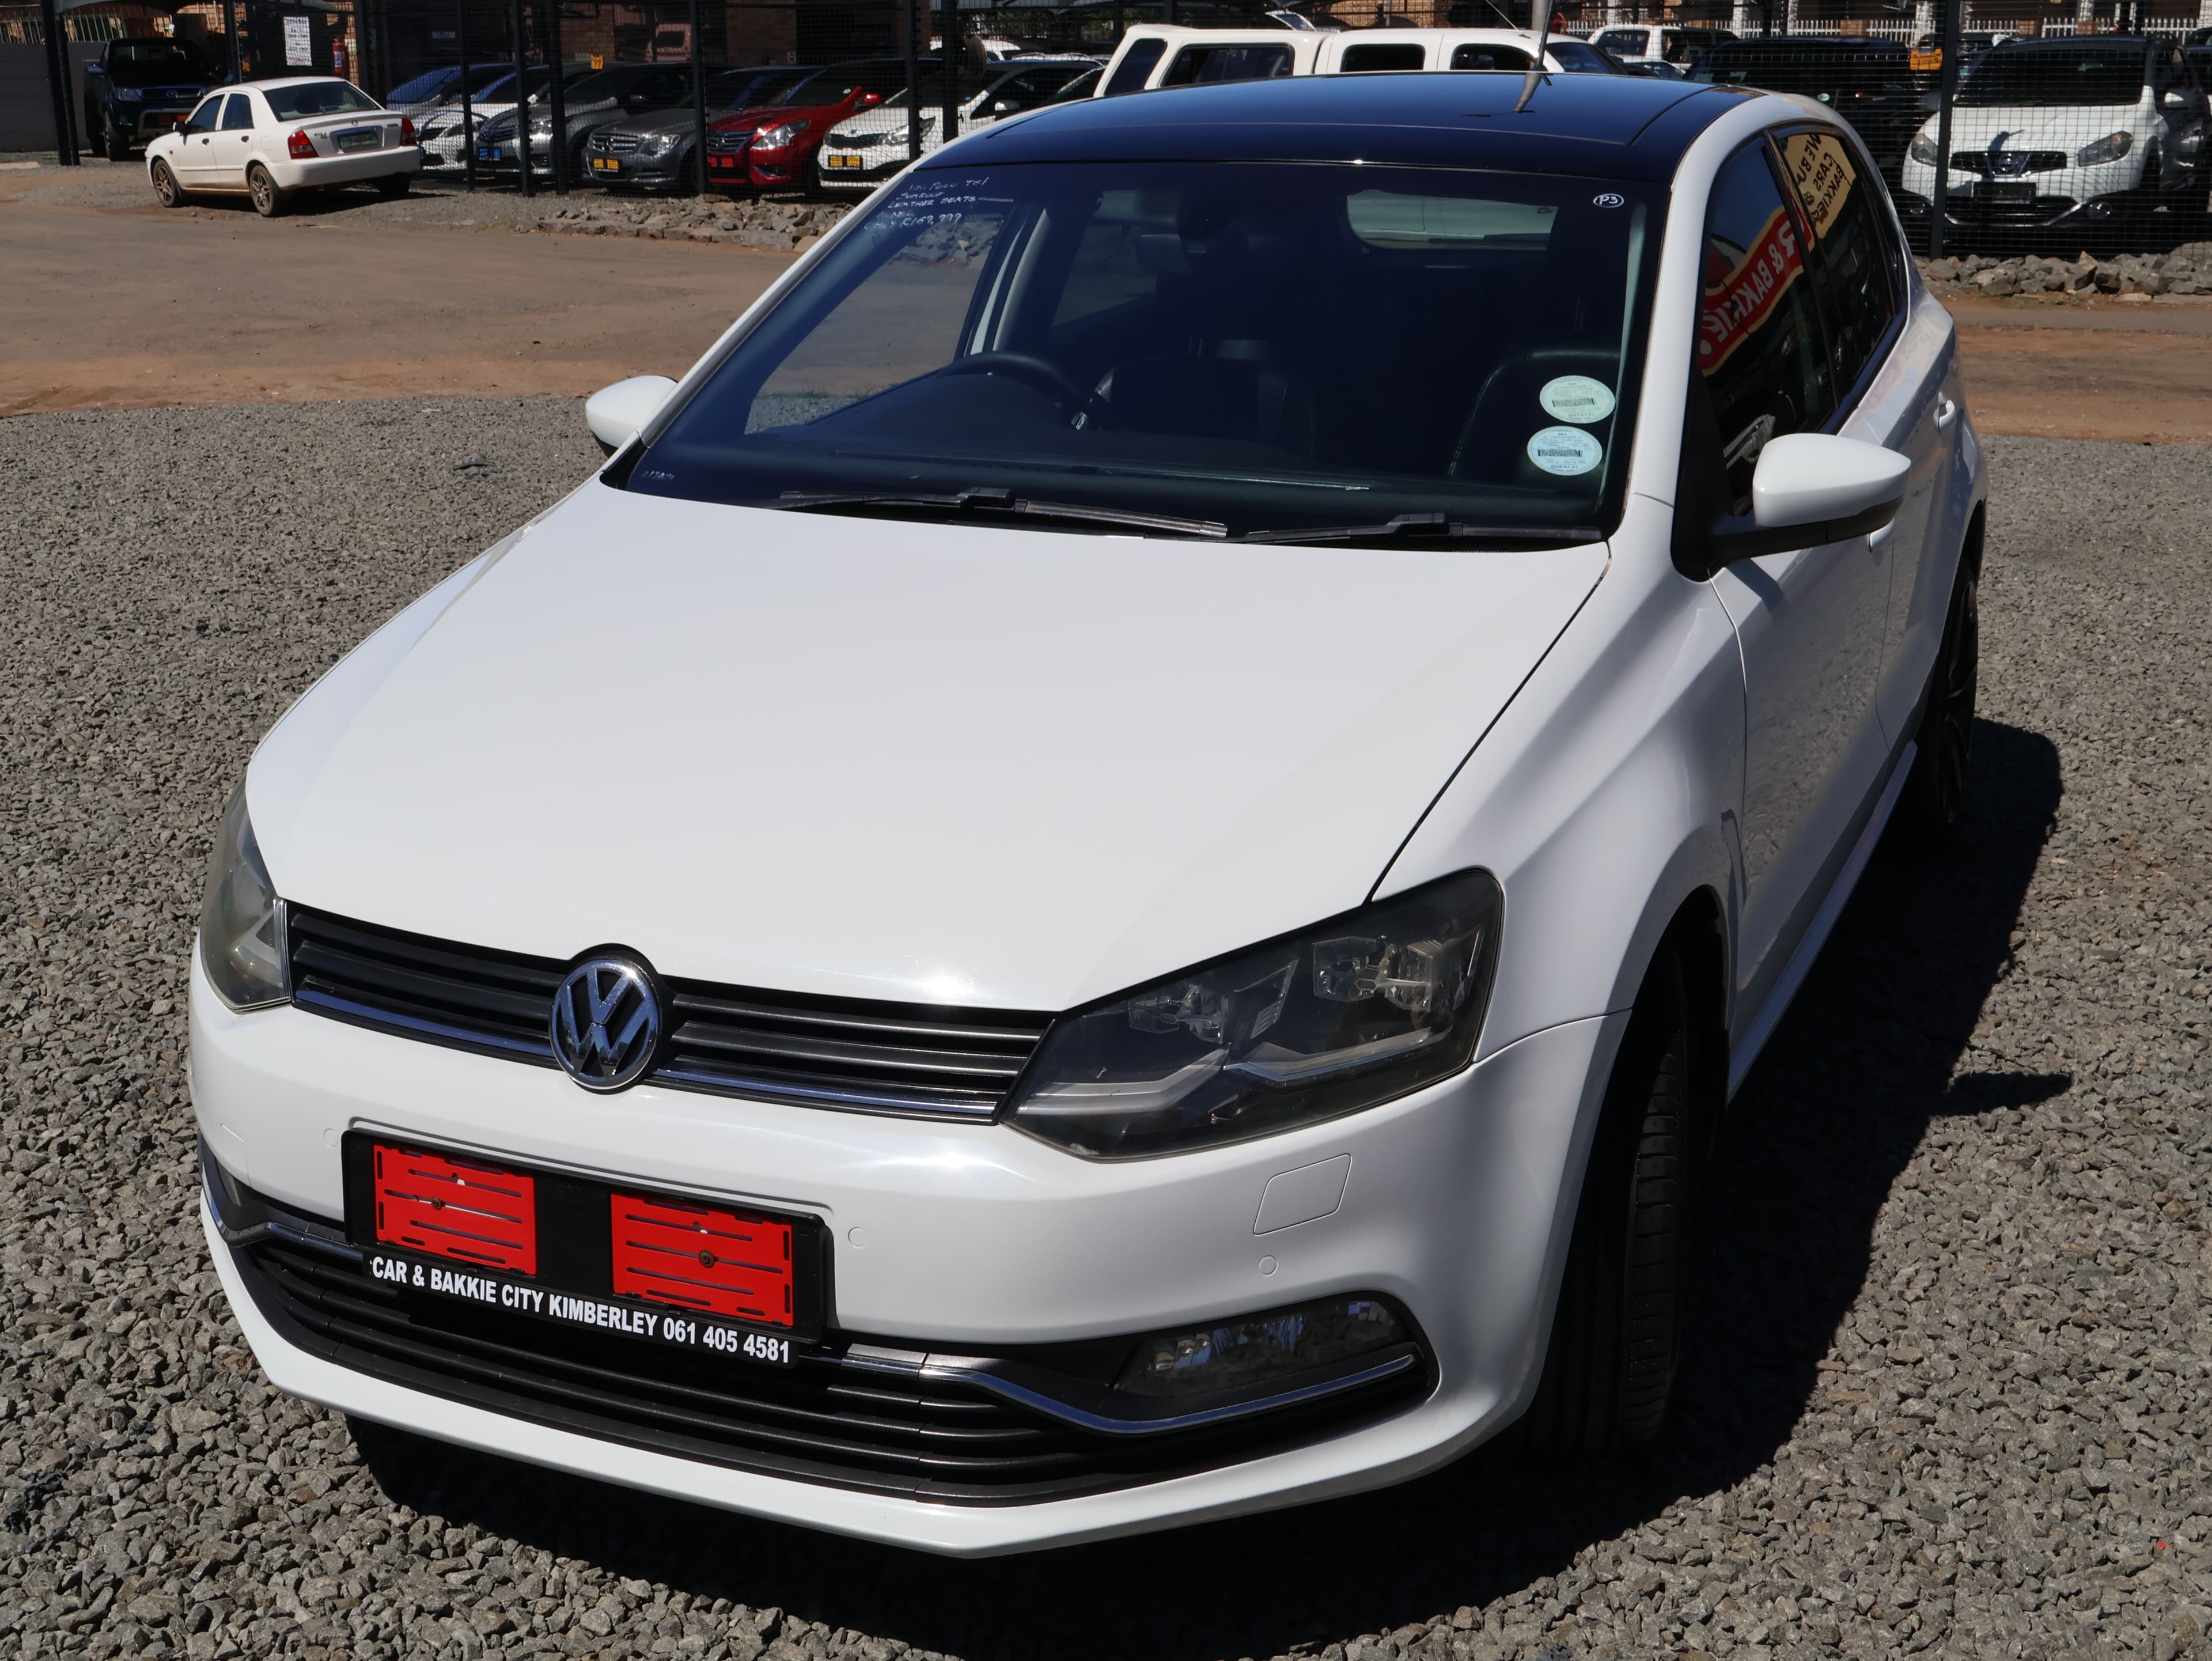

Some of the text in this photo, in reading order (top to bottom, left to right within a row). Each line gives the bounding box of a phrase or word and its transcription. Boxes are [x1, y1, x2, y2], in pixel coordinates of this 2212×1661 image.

[940, 196, 976, 205] SEATS
[1599, 195, 1618, 206] P3
[373, 1257, 789, 1364] CAR & BAKKIE CITY KIMBERLEY 061 405 4581
